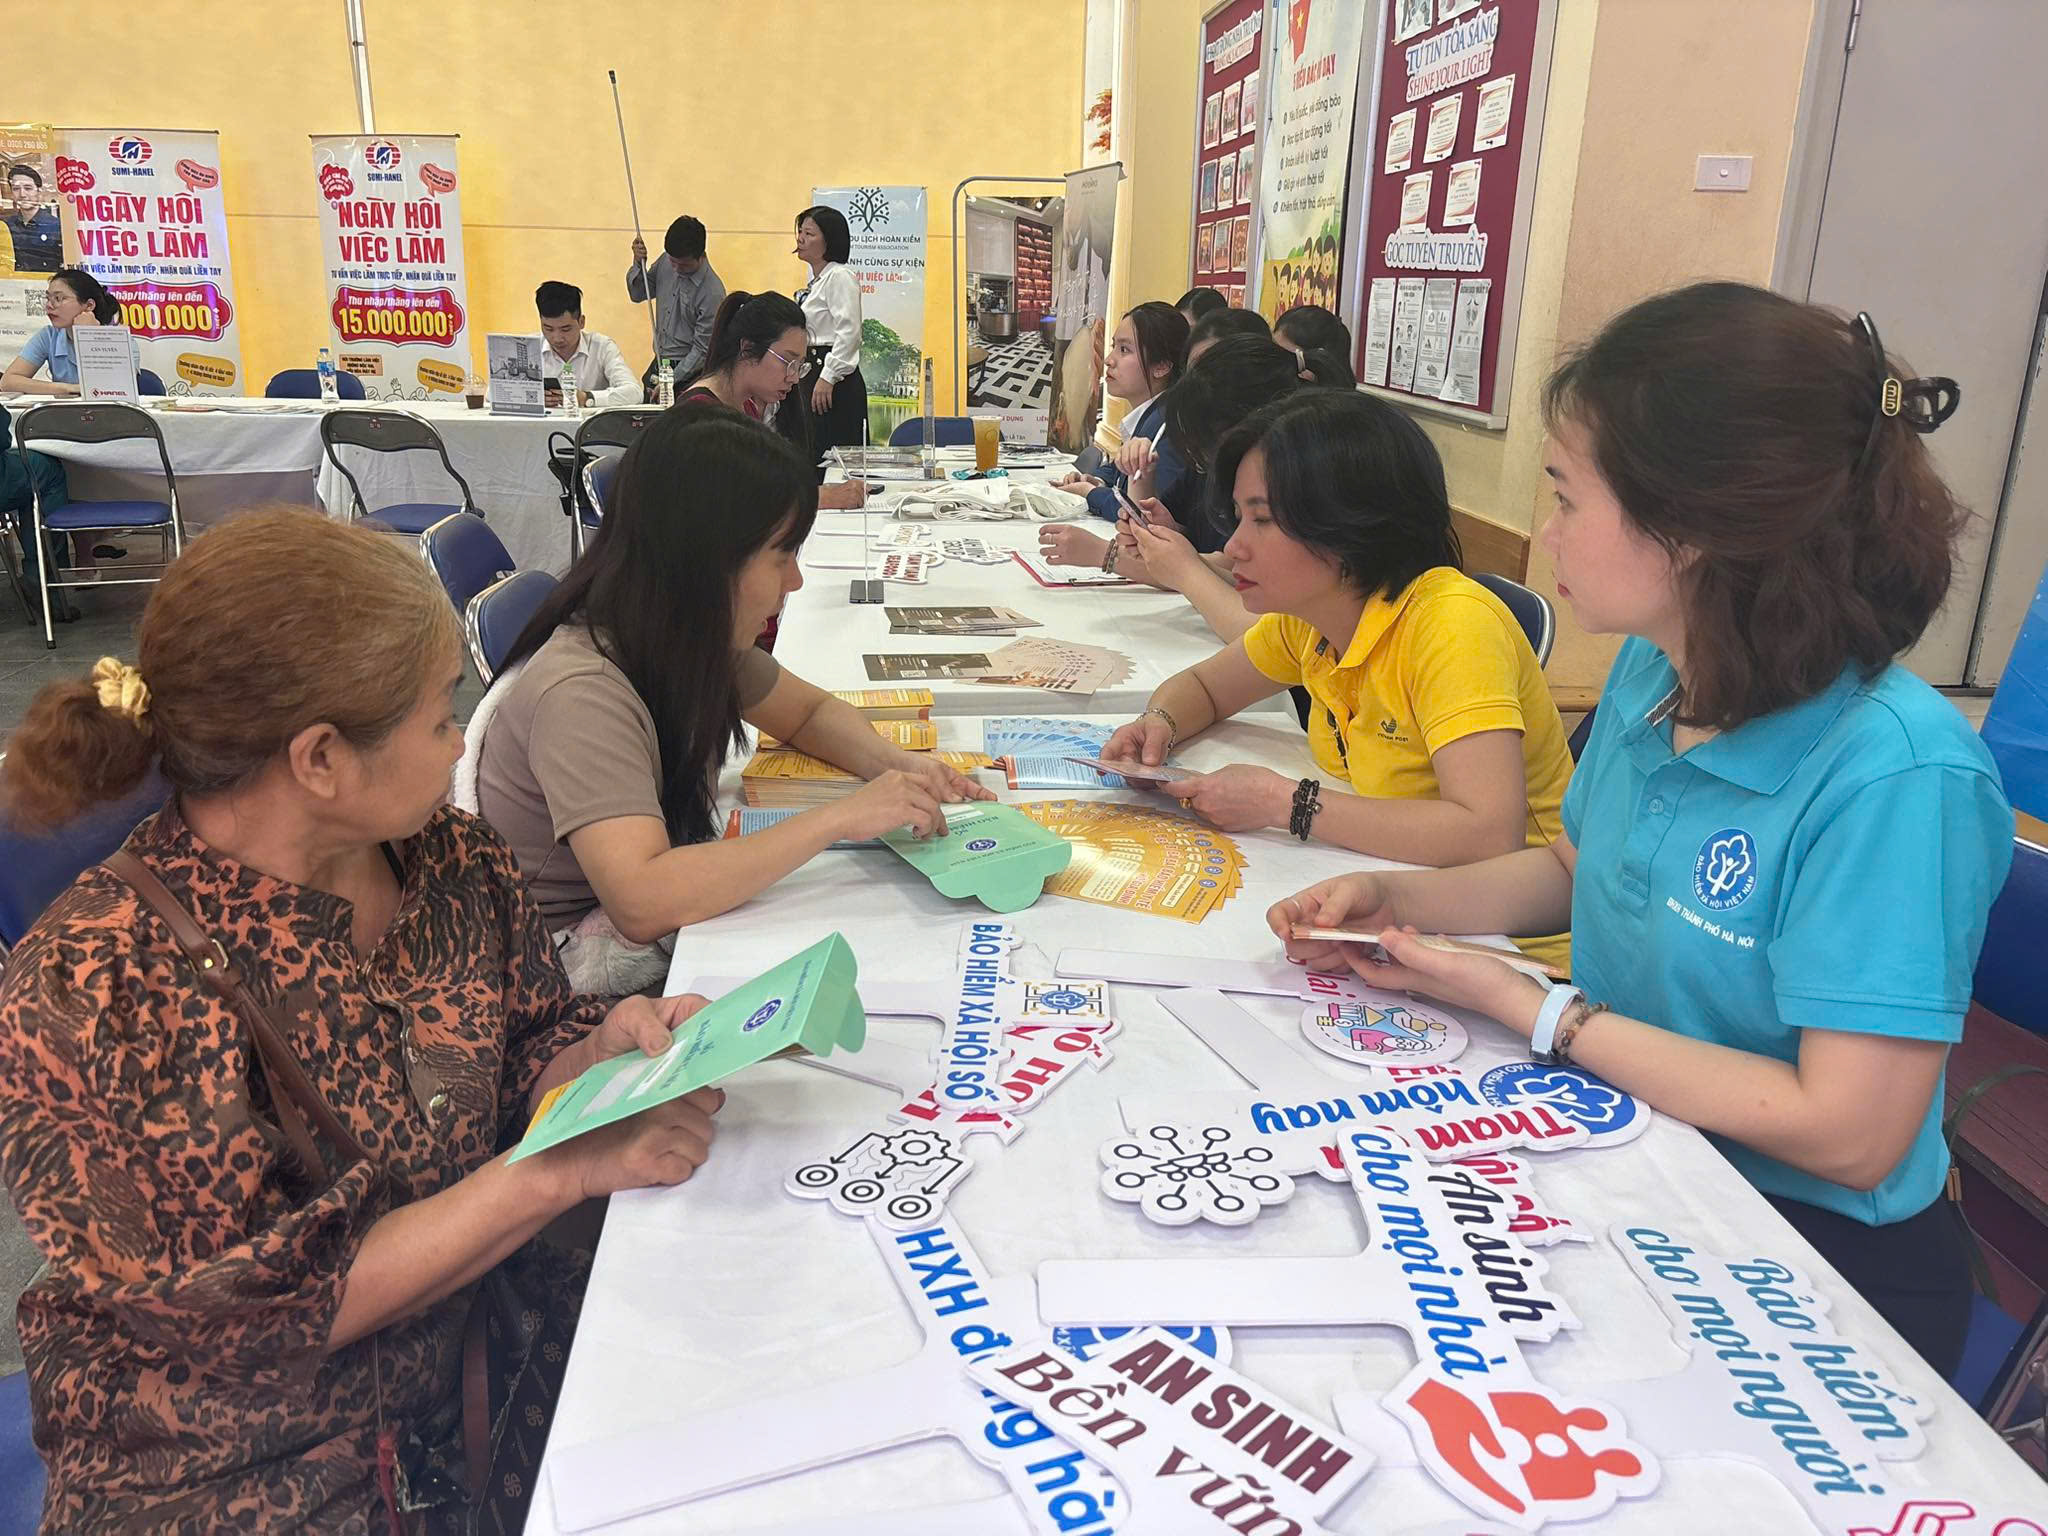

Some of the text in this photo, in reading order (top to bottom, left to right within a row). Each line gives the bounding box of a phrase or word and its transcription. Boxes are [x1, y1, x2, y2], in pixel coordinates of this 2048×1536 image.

[1407, 12, 1497, 73] TỰ TIN TỎA SÁNG
[1407, 48, 1492, 99] SHINE YOUR LIGHT
[1329, 93, 1341, 107] bào
[111, 166, 155, 177] SUMI-HANEL
[76, 190, 204, 230] NGÀY HỘI
[338, 196, 442, 235] NGÀY HỘI
[76, 225, 208, 261] VIỆC LÀM
[338, 230, 446, 268] VIỆC LÀM
[861, 235, 879, 243] LỊCH
[879, 234, 901, 243] HOÀN
[1386, 230, 1485, 266] GÓC TUYÊN TRUYỀN
[90, 262, 106, 274] VIỆC
[107, 263, 123, 274] LÀM
[123, 264, 141, 275] TRỰC
[160, 265, 178, 277] NHẬN
[193, 263, 209, 276] LIỀN
[209, 267, 222, 277] TAY
[349, 268, 362, 280] VIỆC
[363, 268, 376, 280] LÀM
[432, 268, 445, 282] LIỀN
[446, 271, 457, 282] TAY
[864, 257, 889, 267] CÙNG
[891, 258, 904, 268] SỰ
[905, 257, 925, 268] KIỆN
[865, 270, 884, 282] VIỆC
[167, 291, 184, 302] lên
[184, 290, 203, 302] đến
[348, 295, 440, 308] Thu nhập/tháng lên đến
[338, 307, 448, 337] 15.000.000
[1006, 415, 1024, 423] DỤNG
[1709, 900, 1723, 909] HỘI
[1723, 892, 1744, 909] VIỆT
[1741, 875, 1755, 896] NAM
[968, 923, 1013, 957] BẢO
[1680, 906, 1704, 928] THÀNH
[1702, 920, 1721, 938] PHỐ
[1720, 929, 1735, 944] HÀ
[1737, 934, 1755, 949] NỘI
[961, 958, 1015, 997] HIỂM
[957, 1000, 1001, 1026] XÃ
[940, 1030, 999, 1066] HỘI
[944, 1070, 1000, 1102] SỐ
[1250, 1077, 1481, 1135] hôm nay
[1415, 1105, 1577, 1152] Tham
[1350, 1133, 1413, 1197] cho
[1376, 1202, 1464, 1277] mọi
[1426, 1170, 1558, 1323] An sinh
[1407, 1281, 1508, 1380] nhà
[1625, 1227, 1886, 1496] cho mọi người
[1724, 1257, 1918, 1442] Bảo hiểm
[995, 1351, 1148, 1450] Bền
[1108, 1338, 1355, 1495] AN SINH
[1025, 1450, 1116, 1536] hà
